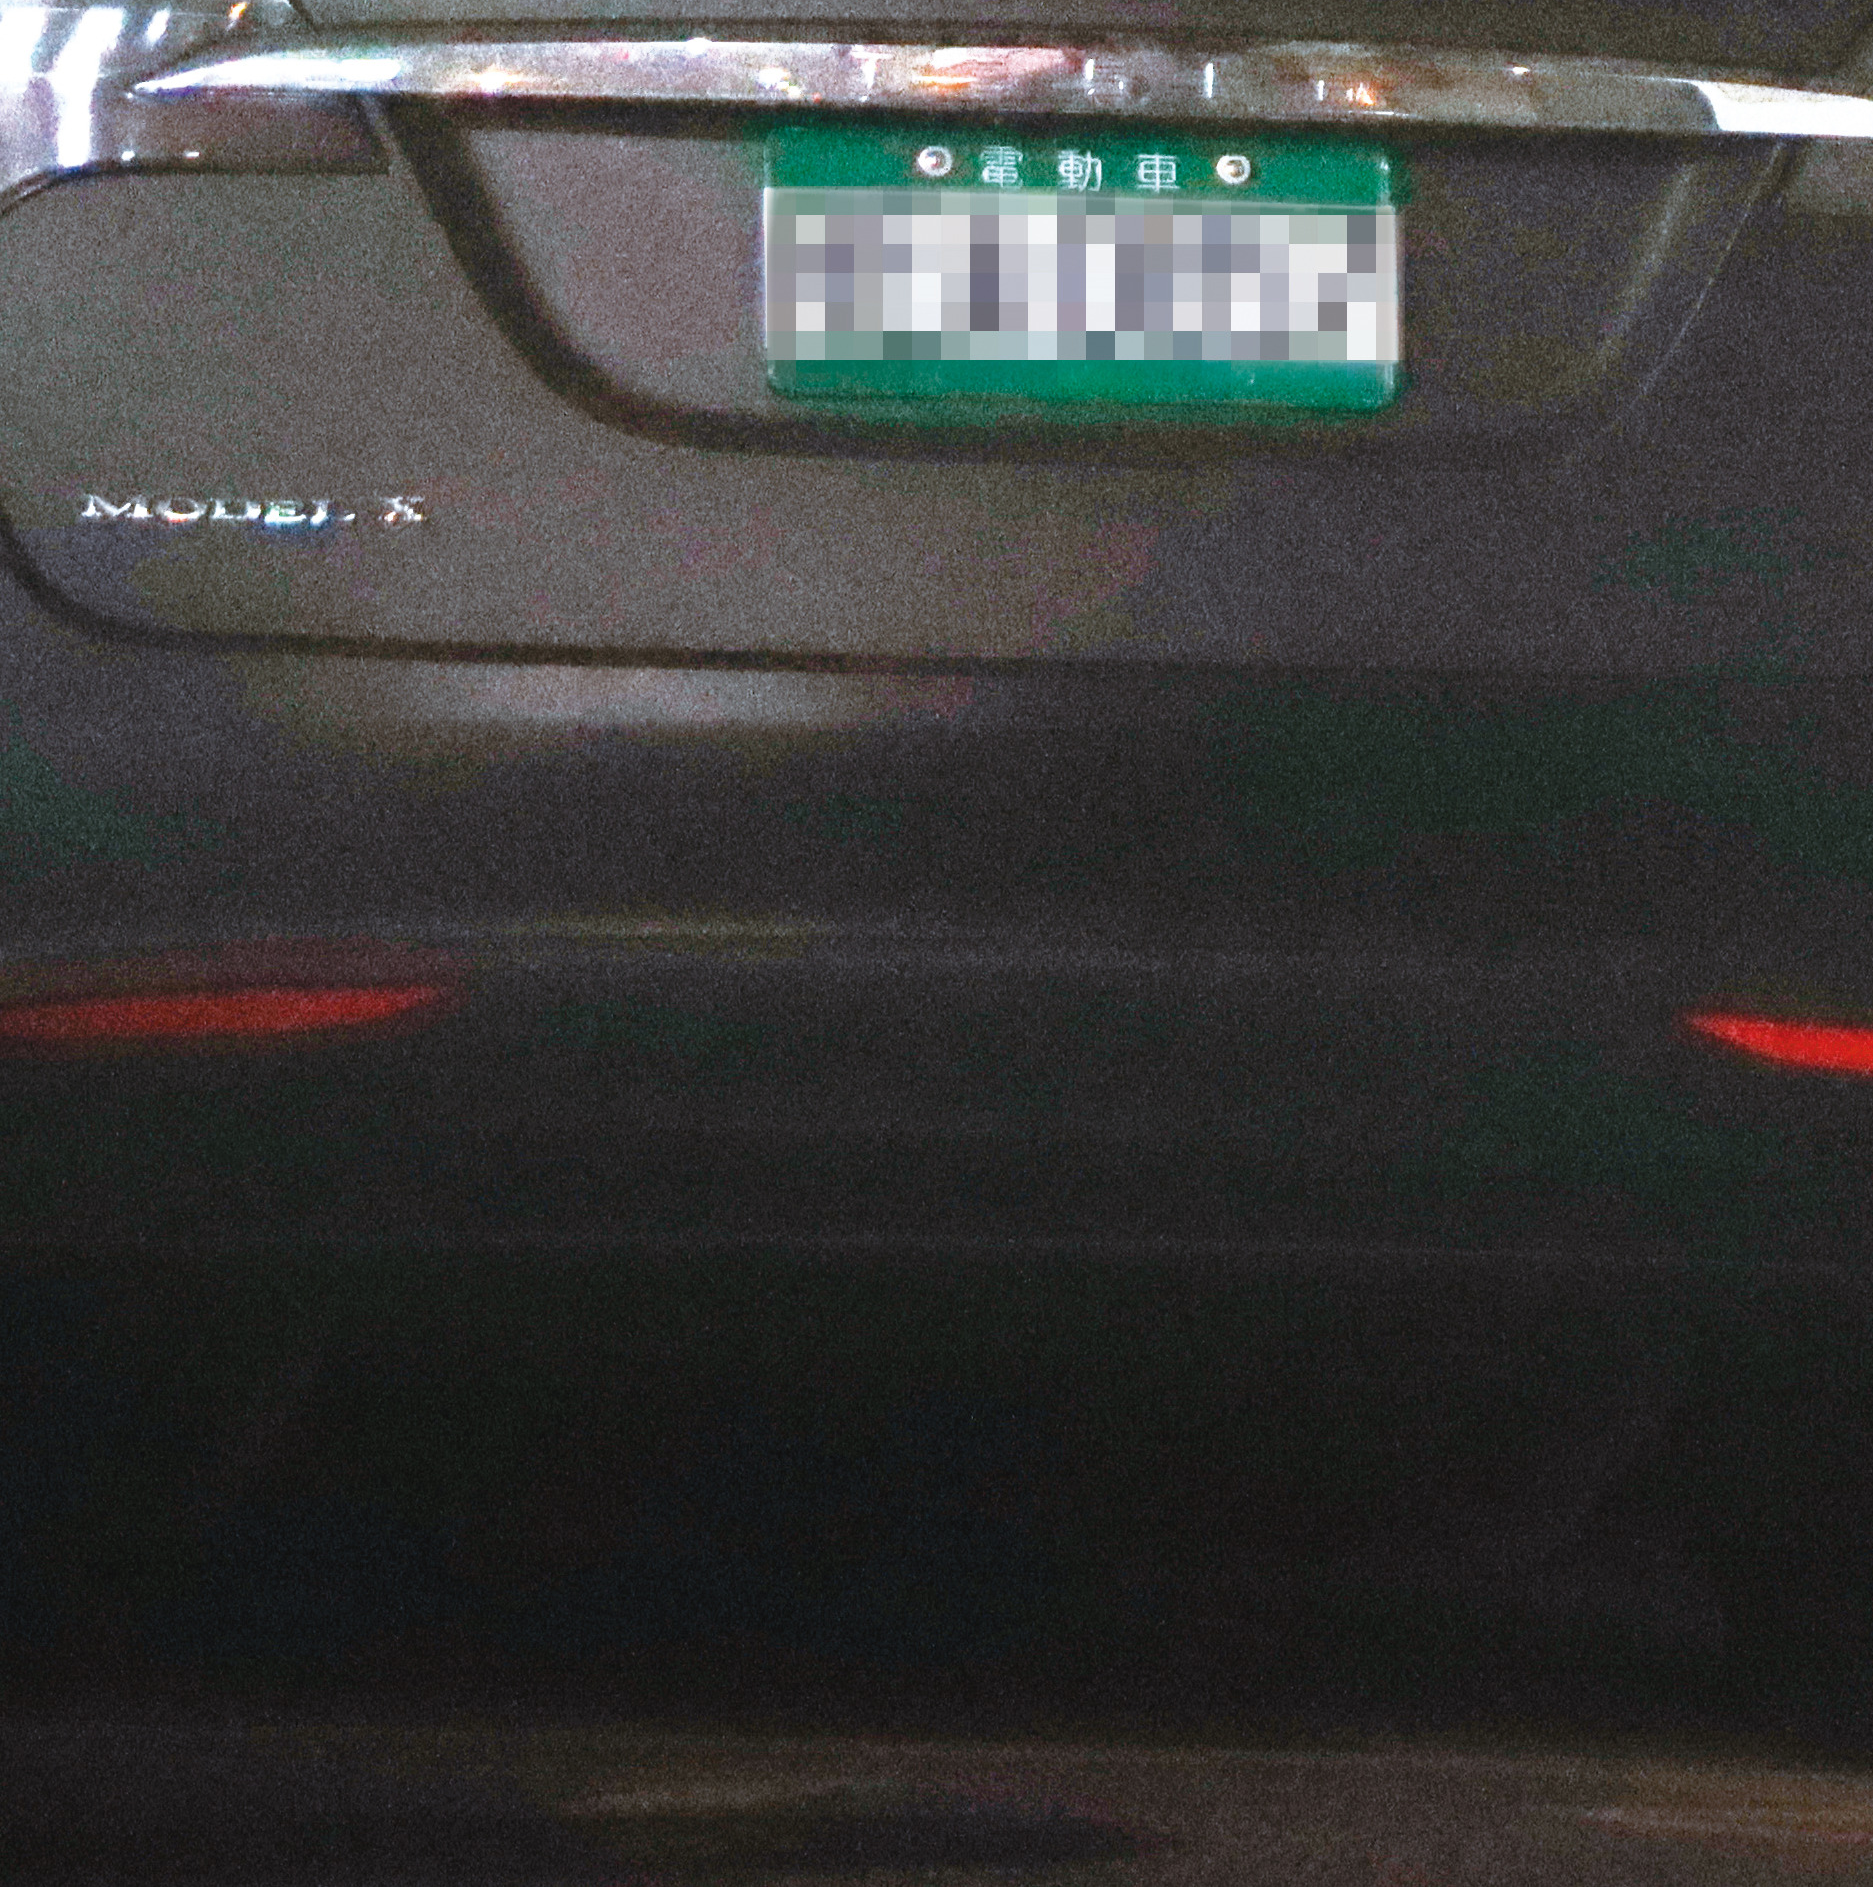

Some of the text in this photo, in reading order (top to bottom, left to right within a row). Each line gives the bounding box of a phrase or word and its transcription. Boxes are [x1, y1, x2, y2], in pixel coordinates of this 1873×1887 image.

[980, 145, 1181, 192] 電動車
[80, 493, 355, 524] MODEL
